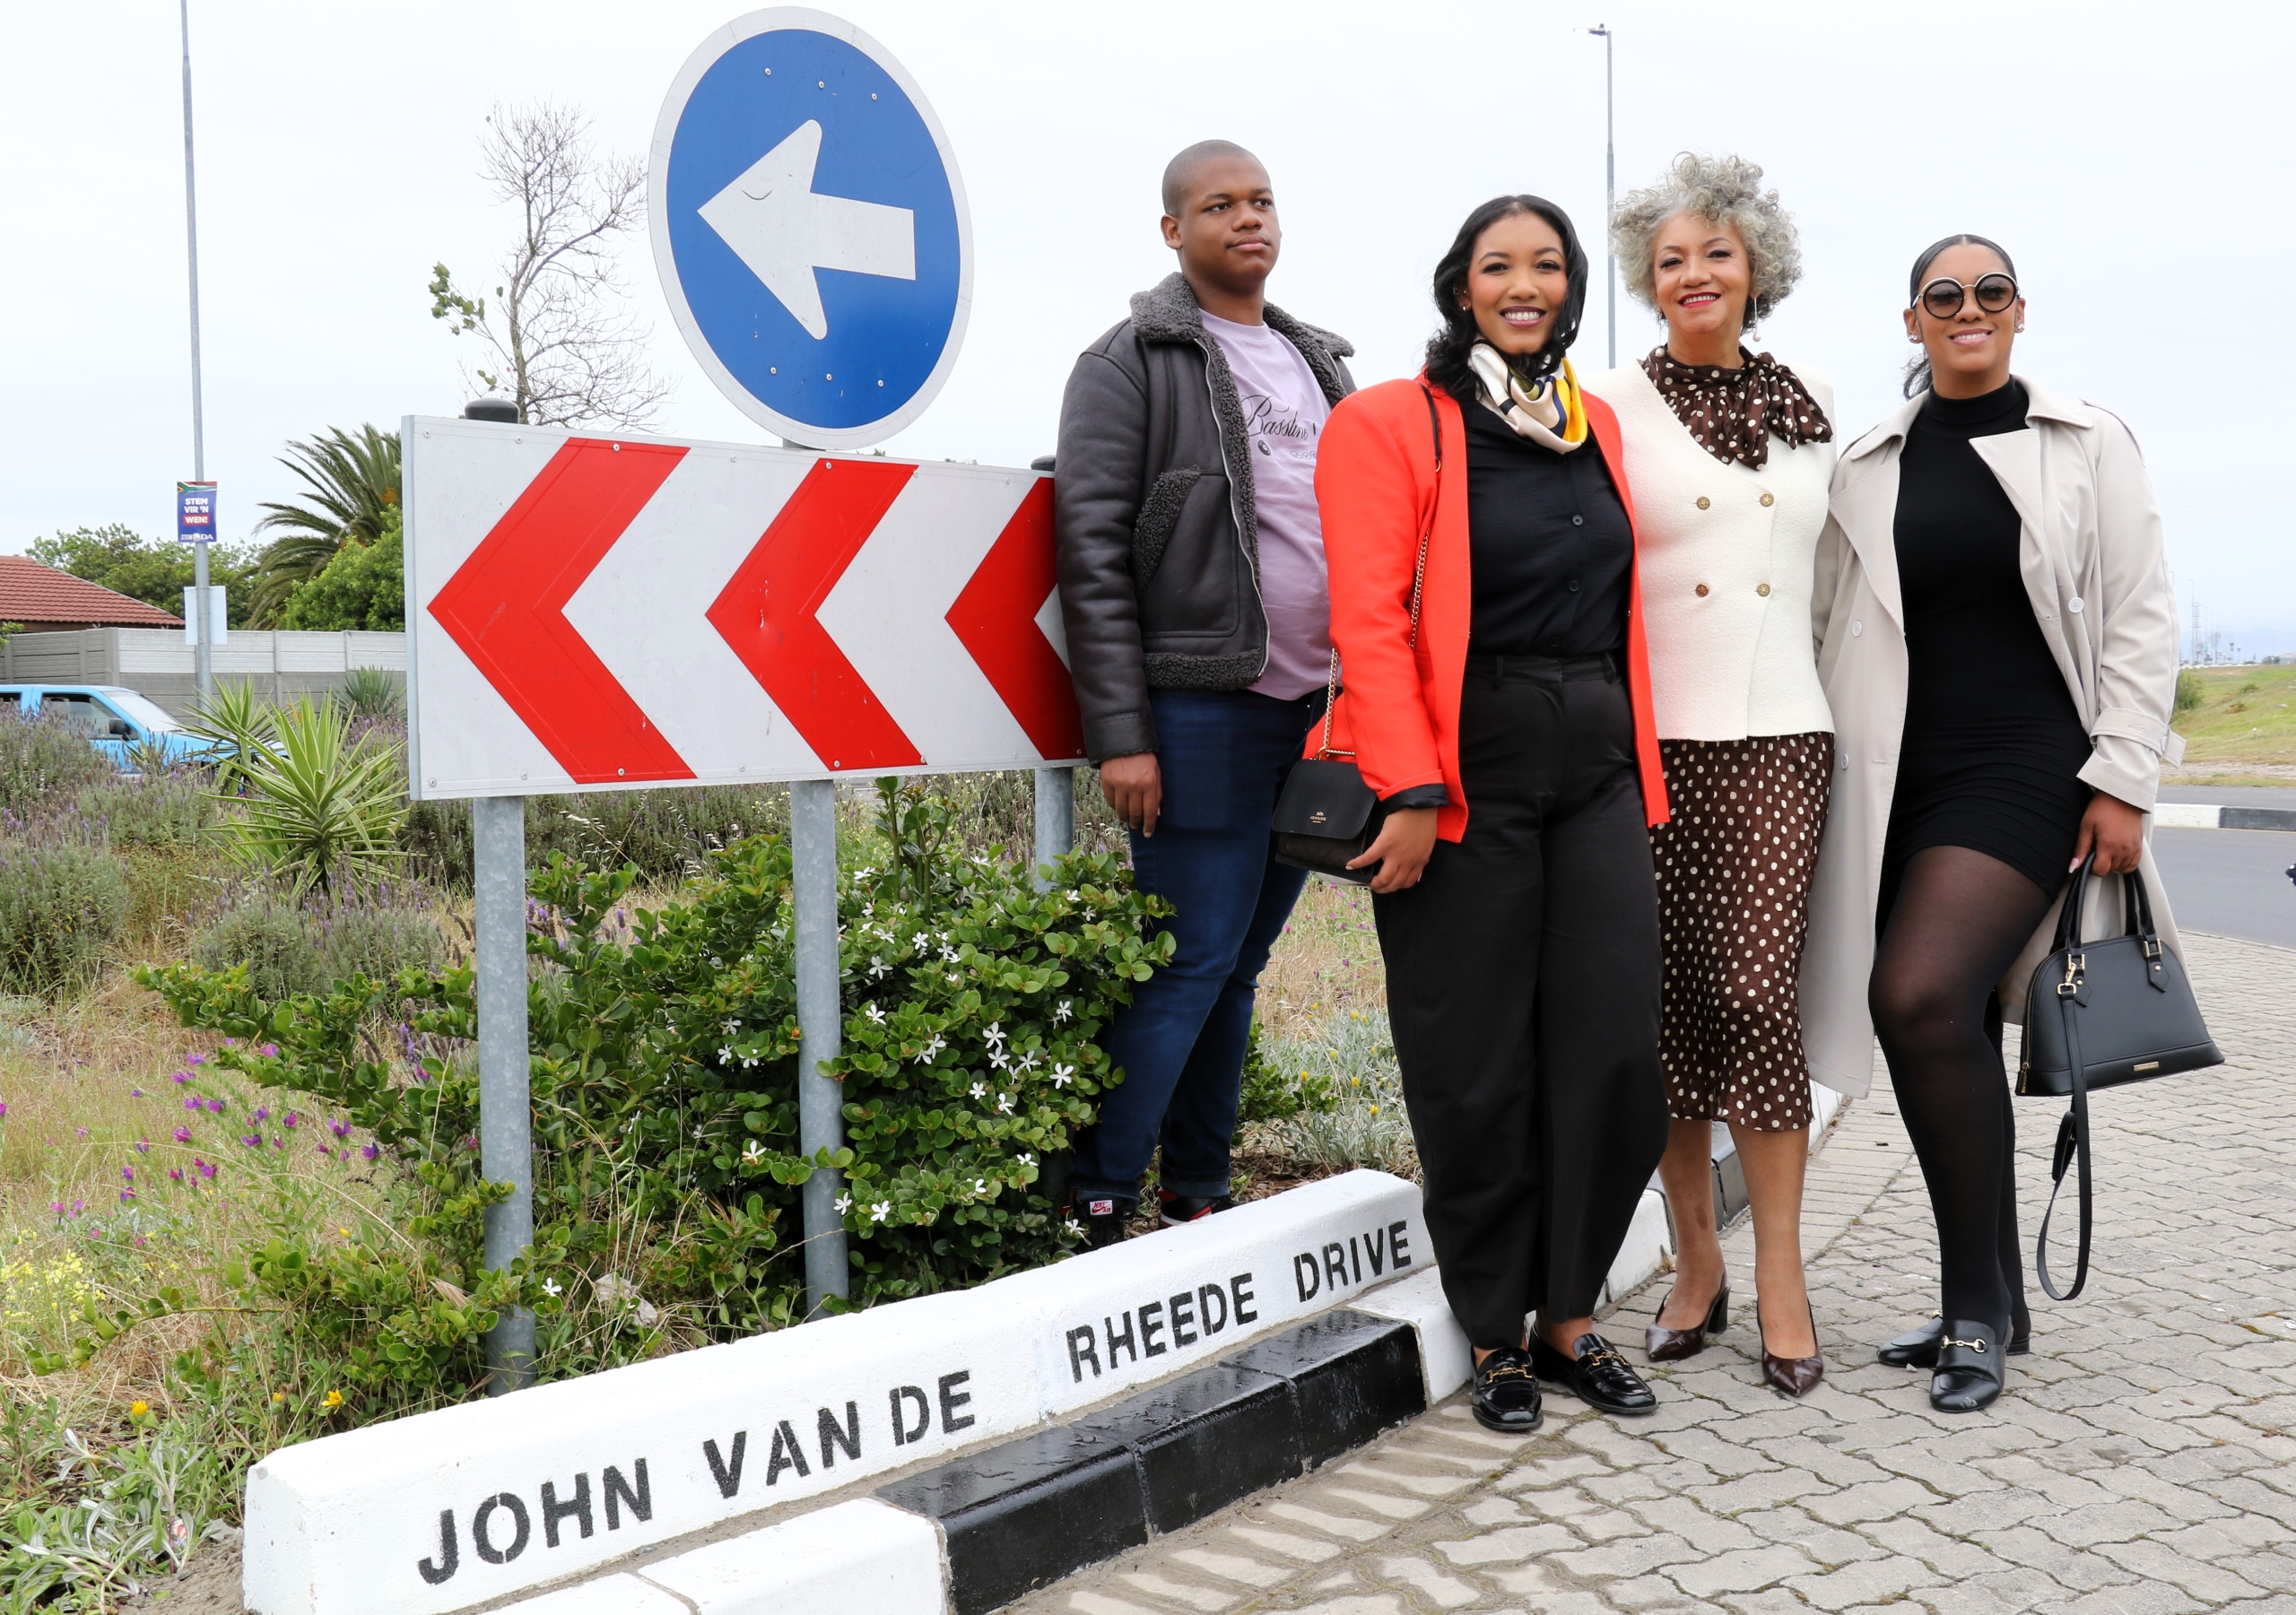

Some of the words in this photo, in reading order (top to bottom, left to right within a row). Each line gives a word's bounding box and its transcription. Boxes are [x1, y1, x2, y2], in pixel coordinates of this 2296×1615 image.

[418, 1457, 652, 1585] JOHN
[702, 1400, 862, 1499] VAN
[889, 1369, 976, 1447] DE
[1065, 1272, 1258, 1383] RHEEDE
[1292, 1219, 1413, 1304] DRIVE
